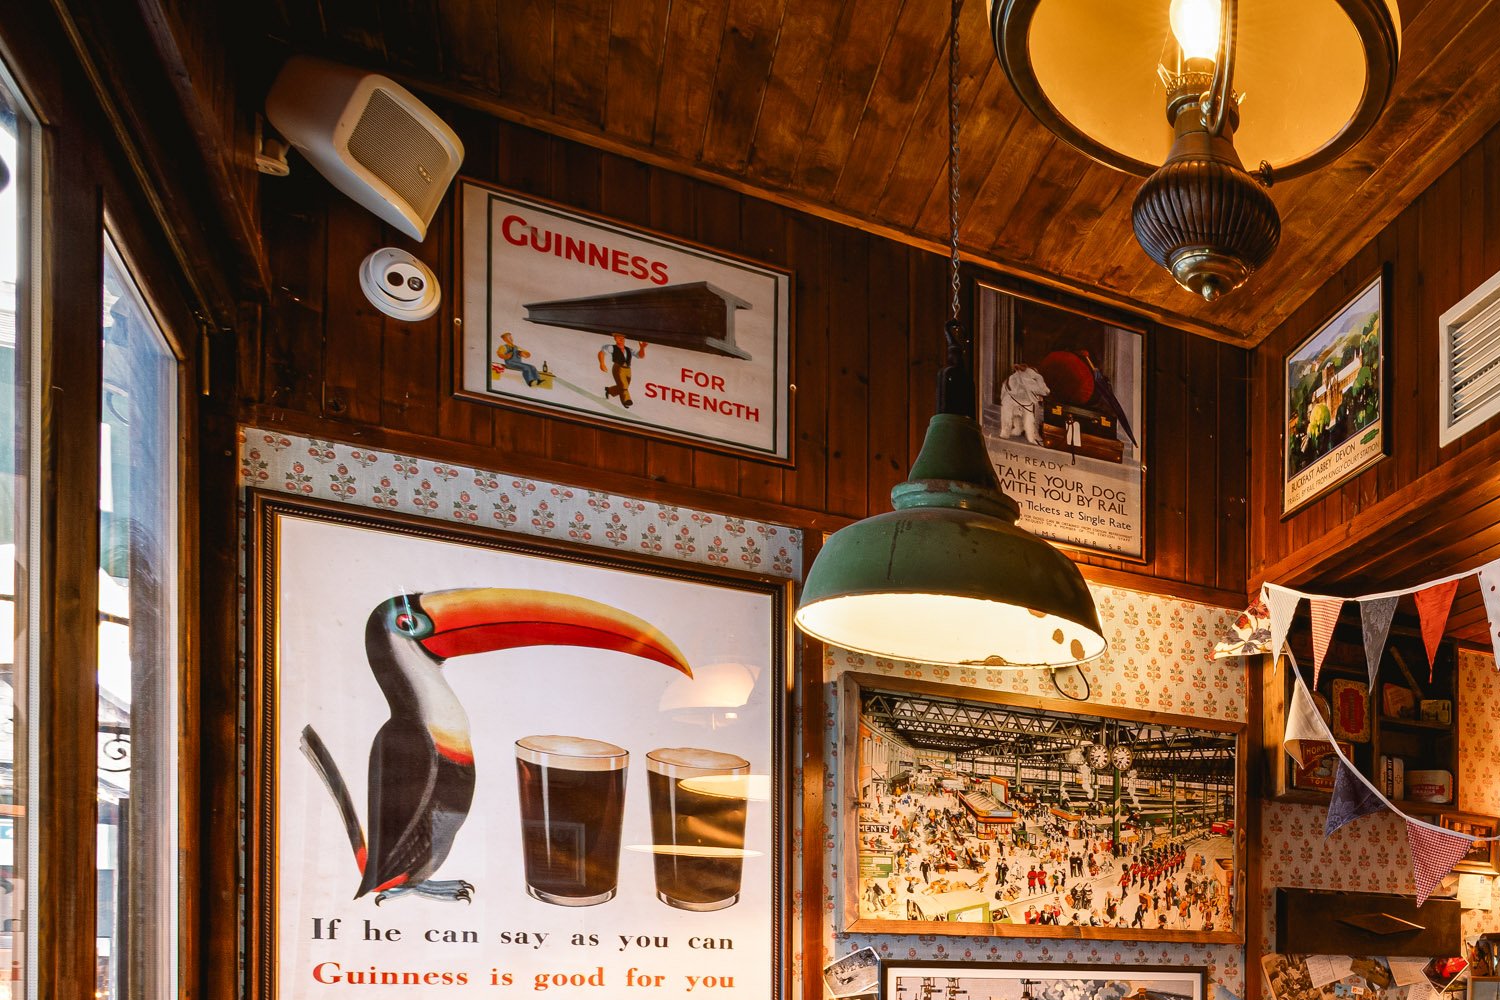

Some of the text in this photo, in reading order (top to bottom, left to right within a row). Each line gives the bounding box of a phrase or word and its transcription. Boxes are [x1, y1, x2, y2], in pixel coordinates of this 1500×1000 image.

[501, 214, 669, 286] GUINNESS
[680, 366, 726, 394] FOR
[644, 381, 761, 424] STRENGTH
[1291, 441, 1356, 493] BUCKFAST ABBEY DEVON
[1315, 474, 1328, 487] FROM
[1328, 464, 1344, 478] KINGLY
[1343, 453, 1360, 469] COURT
[1360, 441, 1380, 461] STATION
[995, 463, 1126, 503] TAKE YOUR DOG
[1000, 478, 1128, 516] WITH YOU BY RAIL
[1026, 499, 1061, 516] Tickets
[1064, 510, 1074, 519] at
[1078, 511, 1106, 526] Single
[1109, 518, 1132, 531] Rate
[1306, 744, 1347, 755] HORNTOS
[1310, 779, 1333, 787] TOFFE
[311, 917, 734, 953] If he can say as you can
[312, 962, 735, 993] Guinness is good for you
